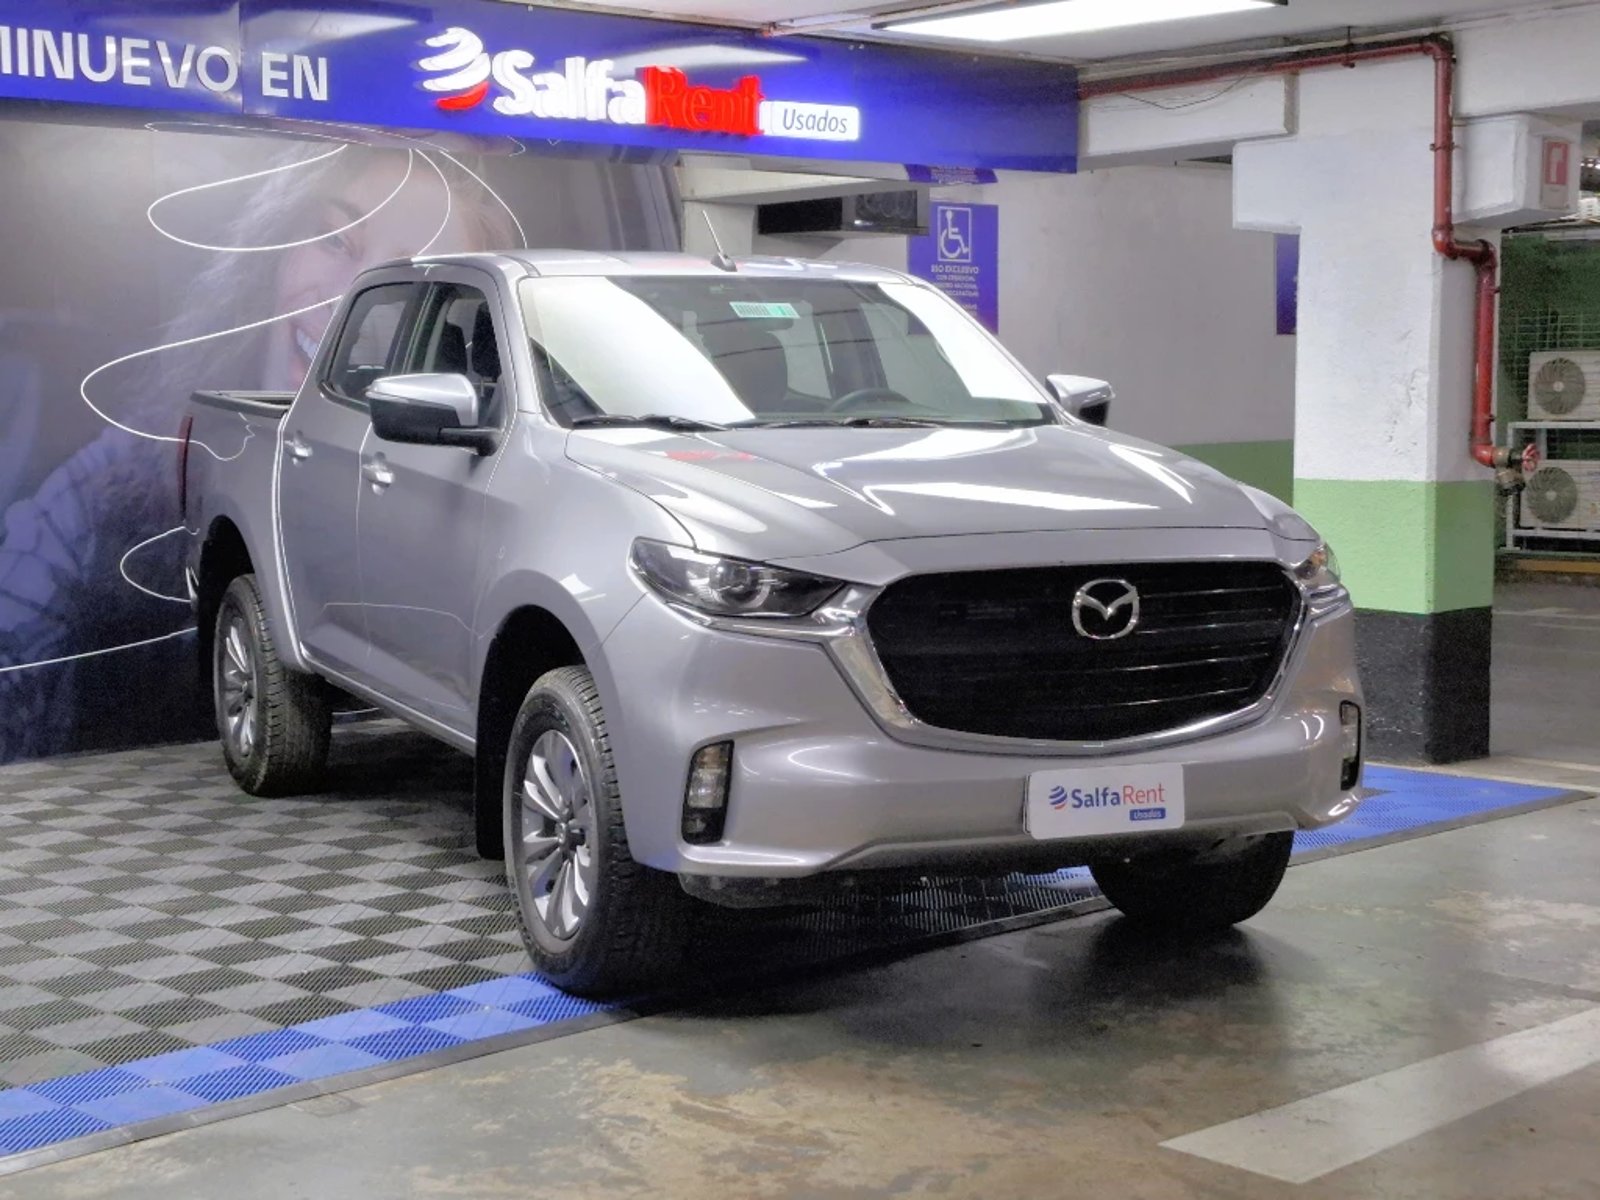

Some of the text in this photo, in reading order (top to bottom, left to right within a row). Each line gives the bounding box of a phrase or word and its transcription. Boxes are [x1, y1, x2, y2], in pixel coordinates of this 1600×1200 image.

[261, 52, 329, 101] EN
[491, 49, 764, 137] SalfaRent
[782, 107, 848, 134] Usados
[1071, 783, 1165, 809] SalfaRent
